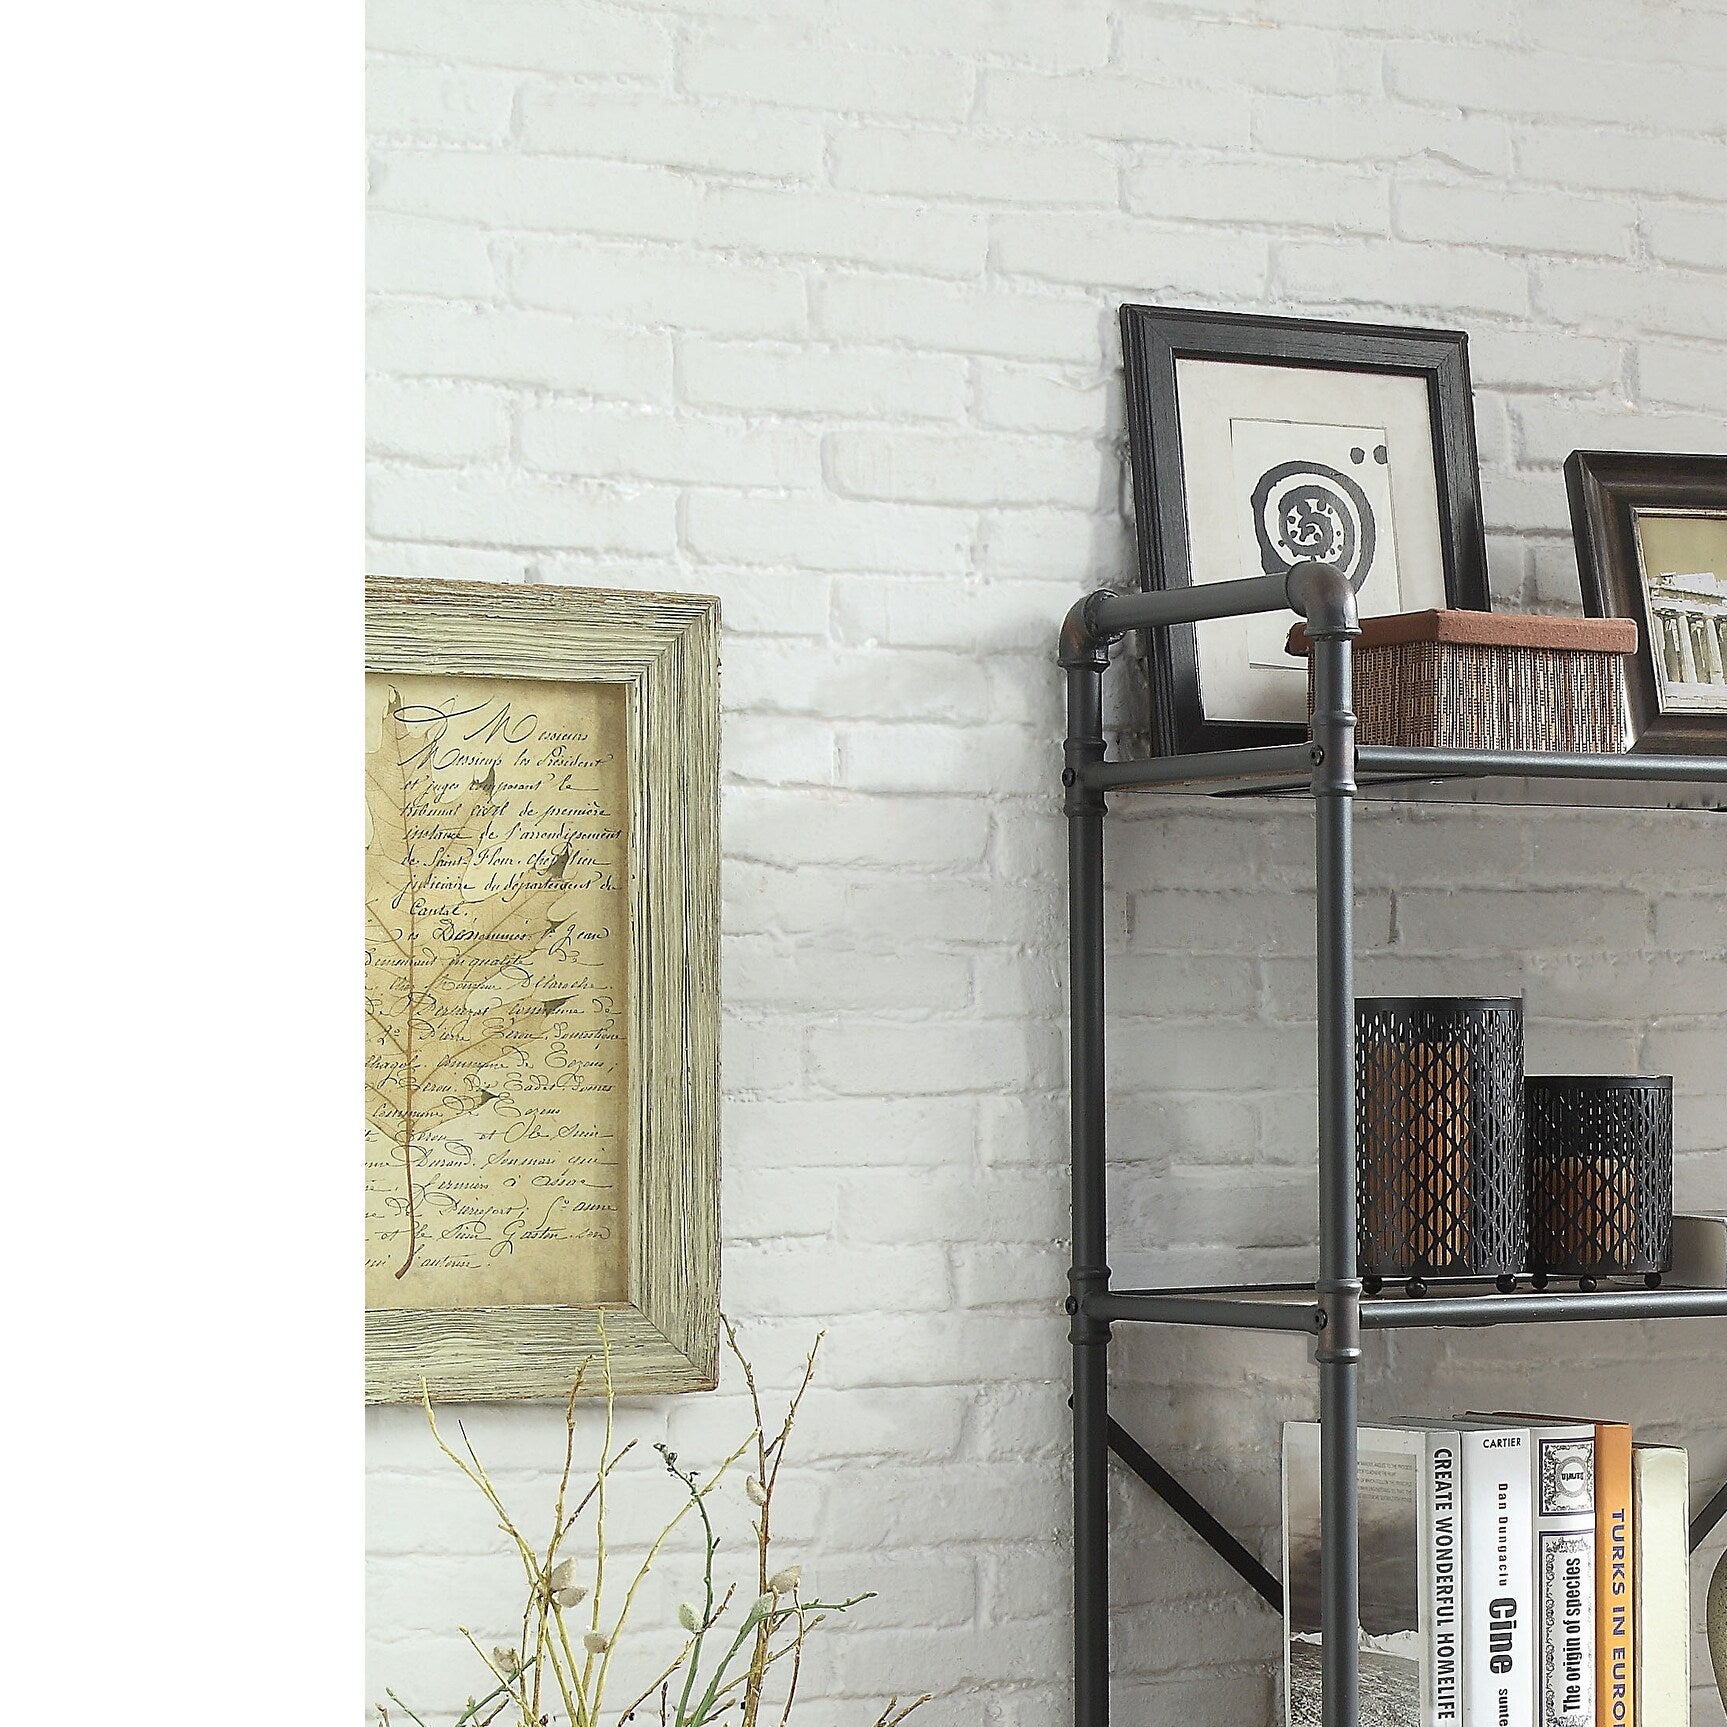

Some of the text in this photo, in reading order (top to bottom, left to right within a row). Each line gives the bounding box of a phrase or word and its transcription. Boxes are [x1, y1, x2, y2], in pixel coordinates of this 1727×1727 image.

[1483, 1438, 1520, 1448] CARTIER
[1498, 1483, 1509, 1587] Dan Dungaciu
[1612, 1509, 1624, 1596] TURKS
[1434, 1449, 1454, 1719] CREATE WONDERFUL HOMELIFE
[1613, 1607, 1625, 1637] IN
[1489, 1597, 1517, 1674] Cine
[1562, 1558, 1582, 1712] The origin of species
